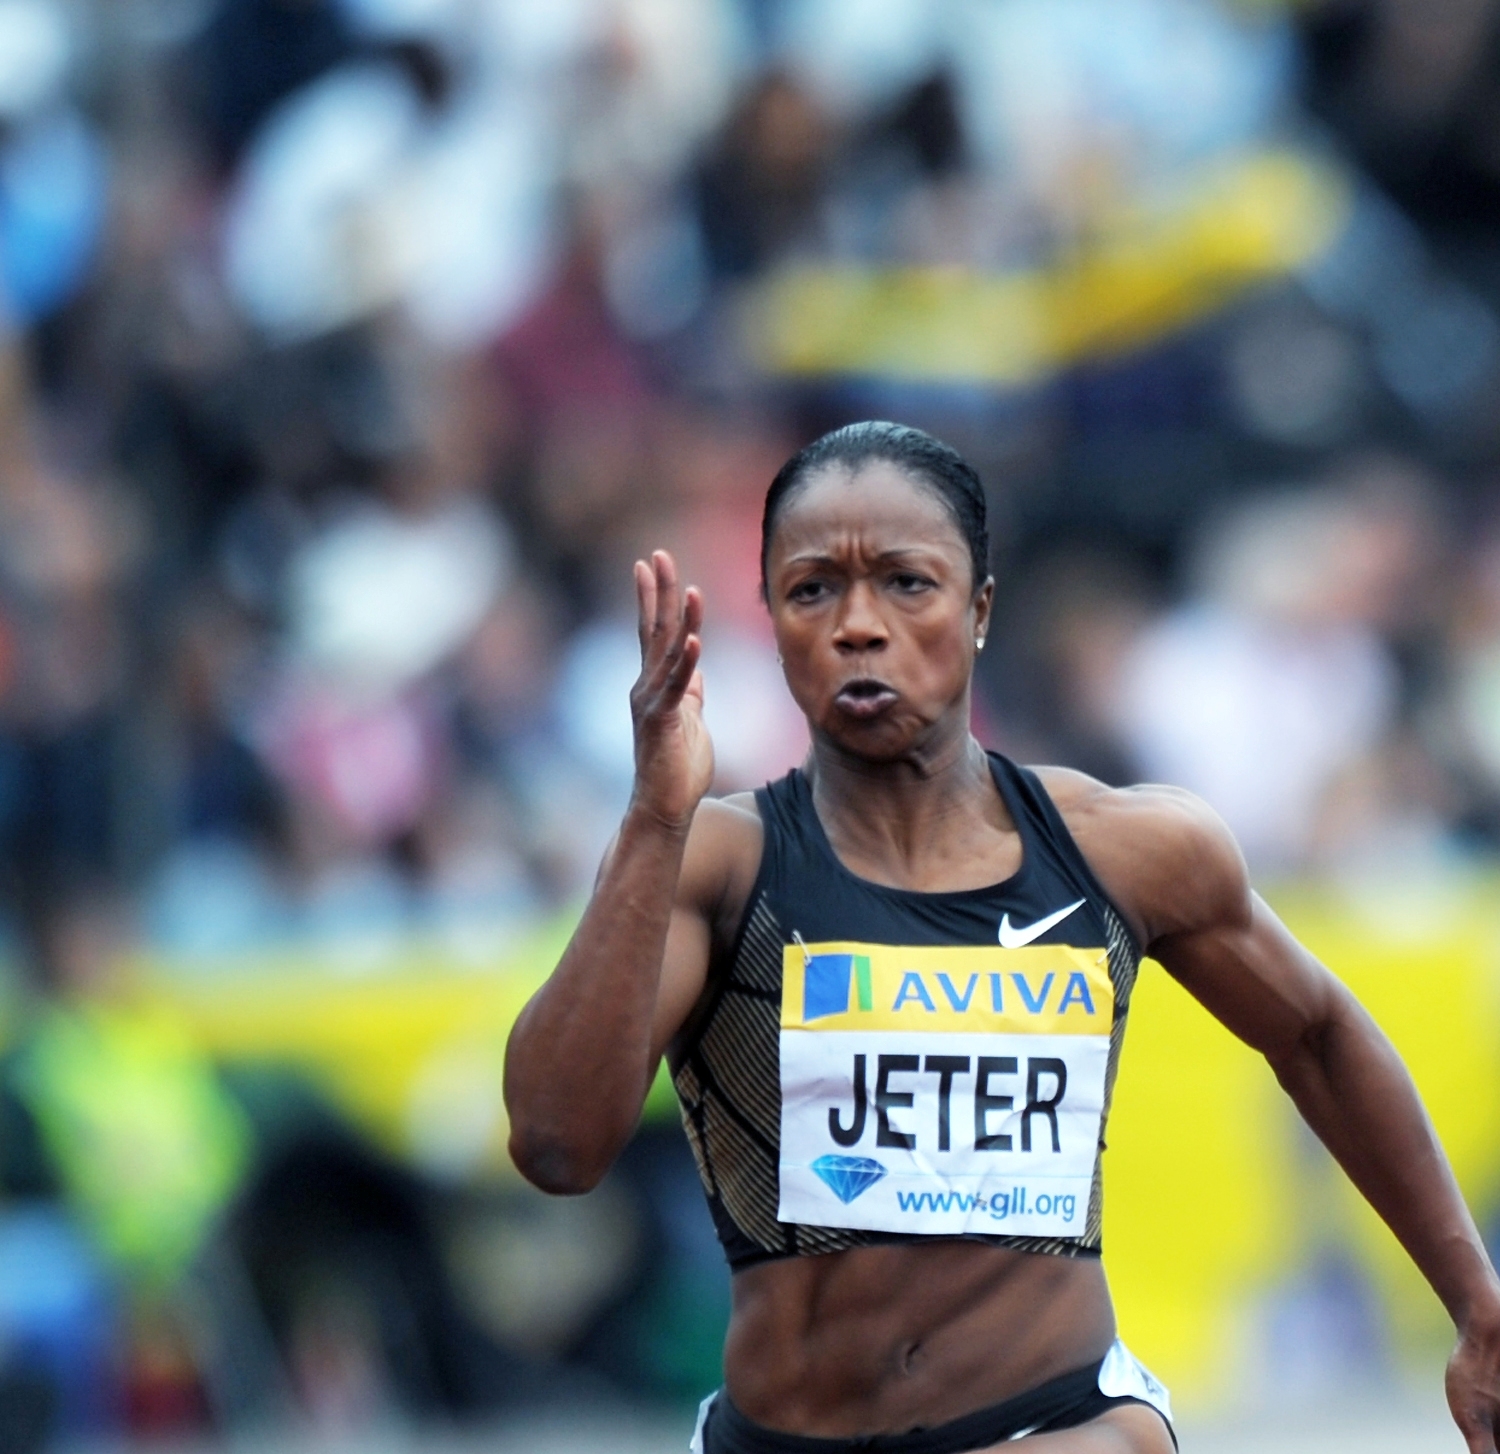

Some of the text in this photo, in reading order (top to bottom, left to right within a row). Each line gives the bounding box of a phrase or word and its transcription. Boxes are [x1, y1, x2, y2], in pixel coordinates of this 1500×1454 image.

[892, 971, 1097, 1015] AVIVA
[828, 1053, 1068, 1153] JETER
[897, 1186, 1075, 1222] www.gll.org
